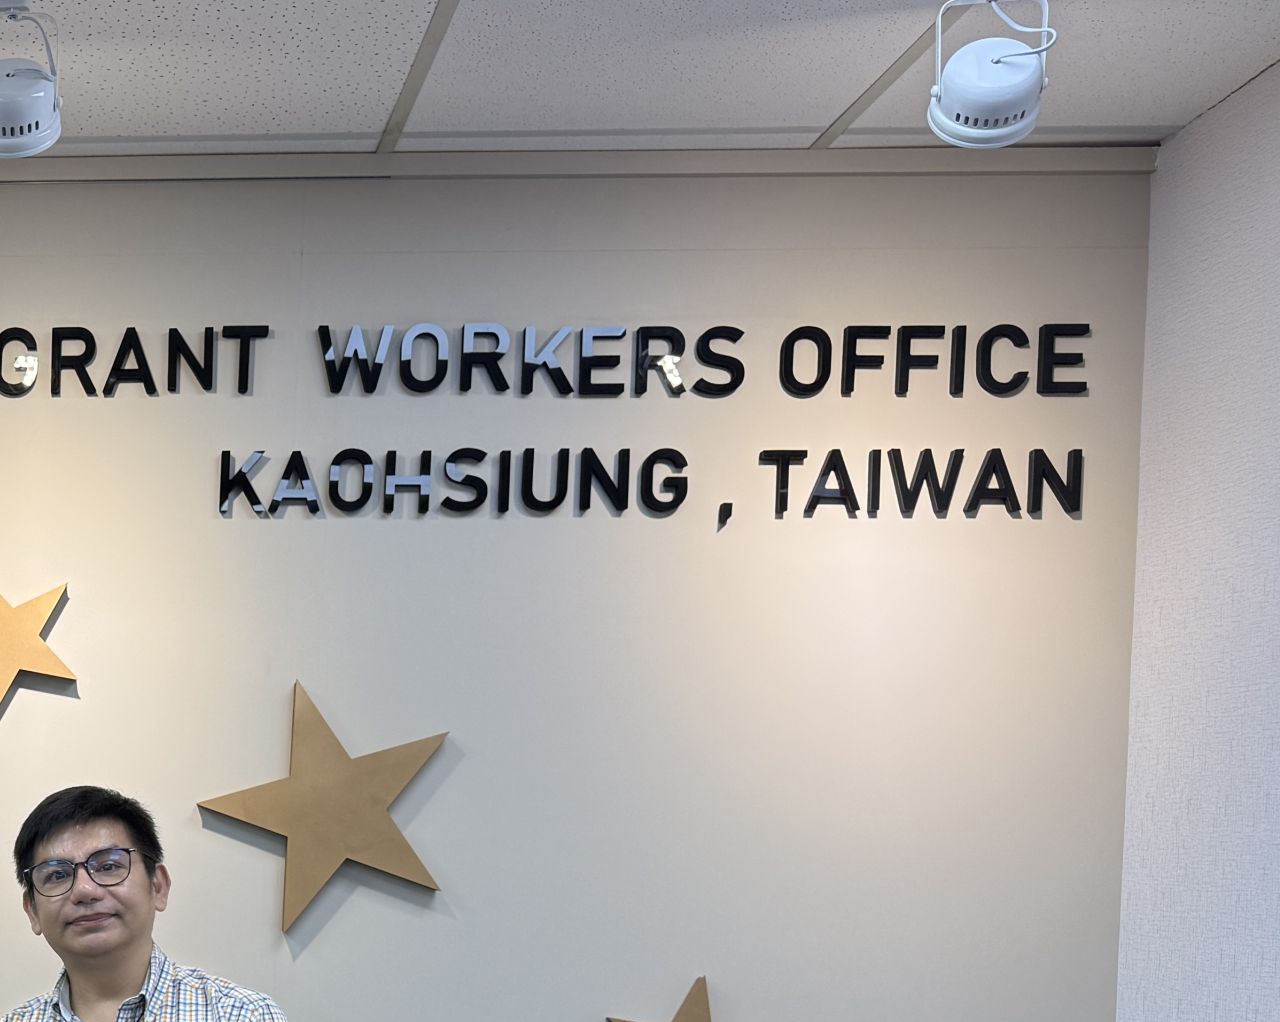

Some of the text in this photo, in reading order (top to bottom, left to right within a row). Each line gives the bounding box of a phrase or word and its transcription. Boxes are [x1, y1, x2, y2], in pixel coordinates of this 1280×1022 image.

[318, 323, 745, 397] WORKERS
[779, 323, 1090, 397] OFFICE
[219, 446, 688, 517] KAOHSIUNG
[759, 447, 1083, 519] TAIWAN
